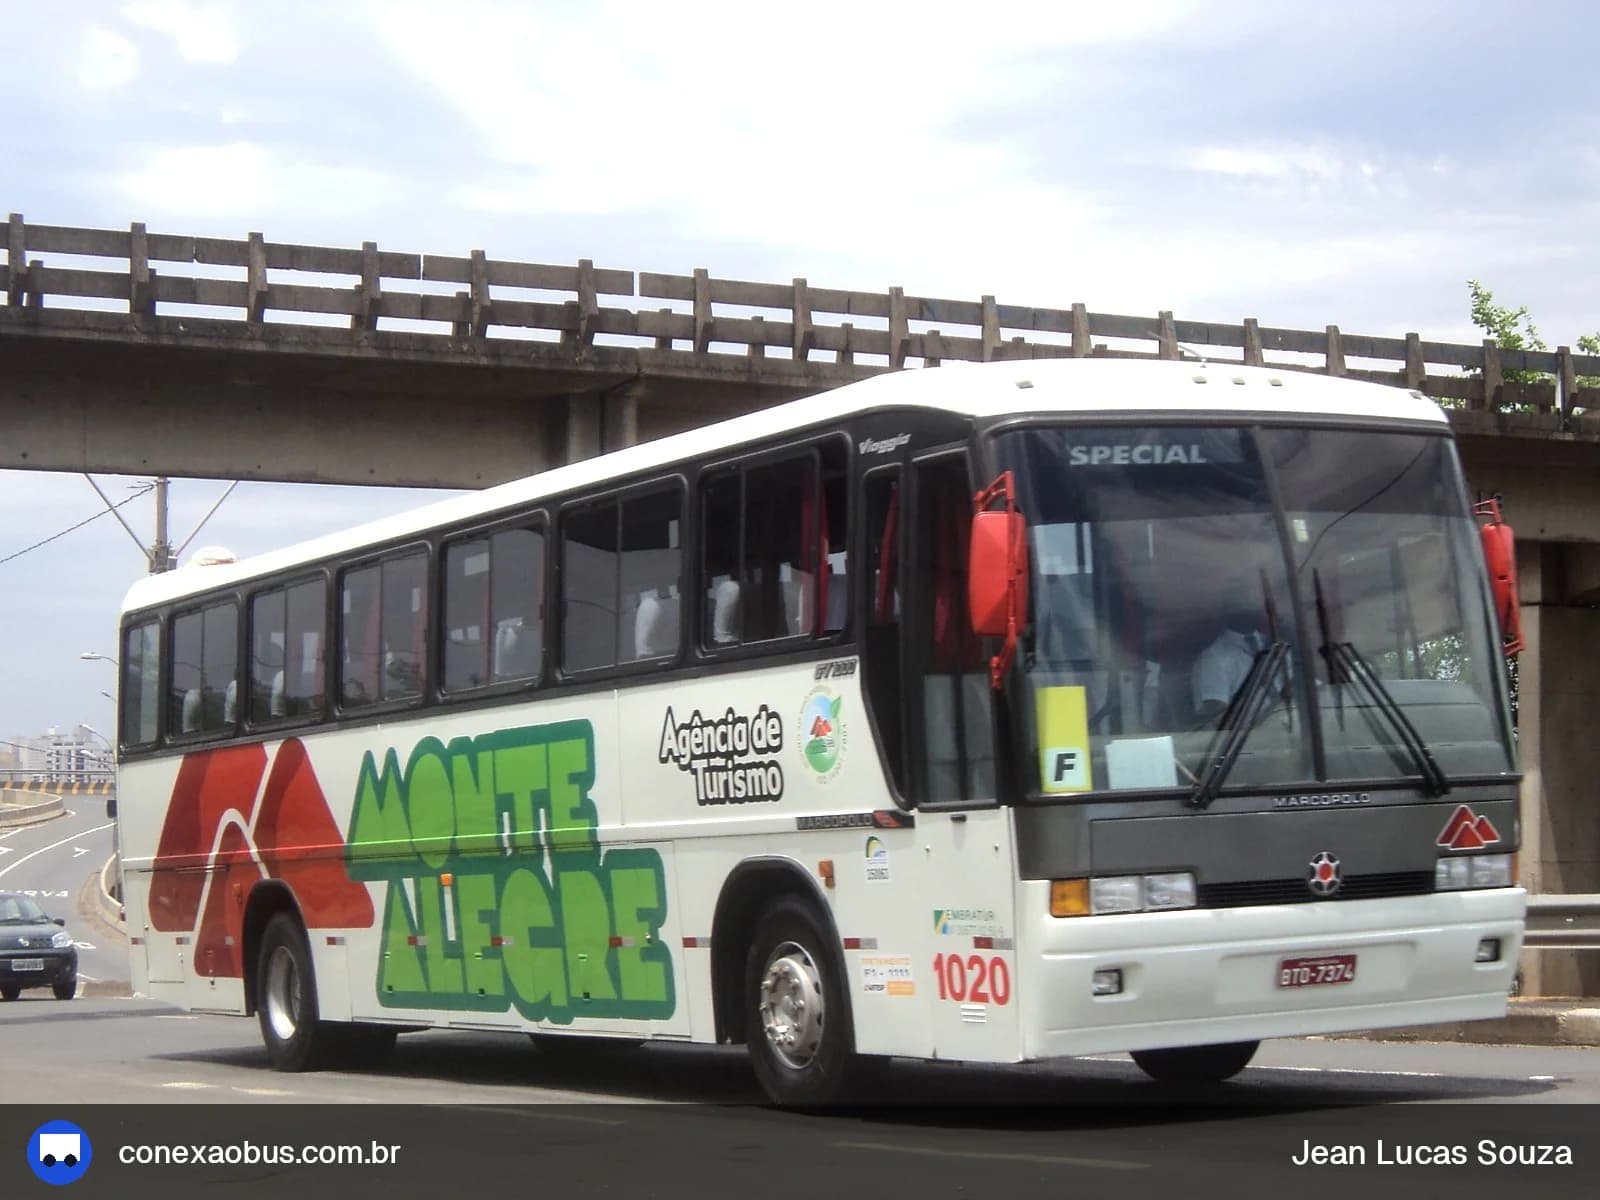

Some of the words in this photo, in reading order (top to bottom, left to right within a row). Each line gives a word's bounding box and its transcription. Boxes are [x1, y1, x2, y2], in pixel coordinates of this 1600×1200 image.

[1069, 444, 1207, 466] SPECIAL
[659, 705, 749, 772] Agência
[751, 704, 783, 755] de
[690, 756, 784, 806] Turismo
[1053, 752, 1076, 782] F
[346, 718, 599, 882] MONTE
[1273, 793, 1370, 808] MARCOPOLO
[376, 848, 676, 1025] ALEGRE
[933, 953, 1010, 1006] 1020
